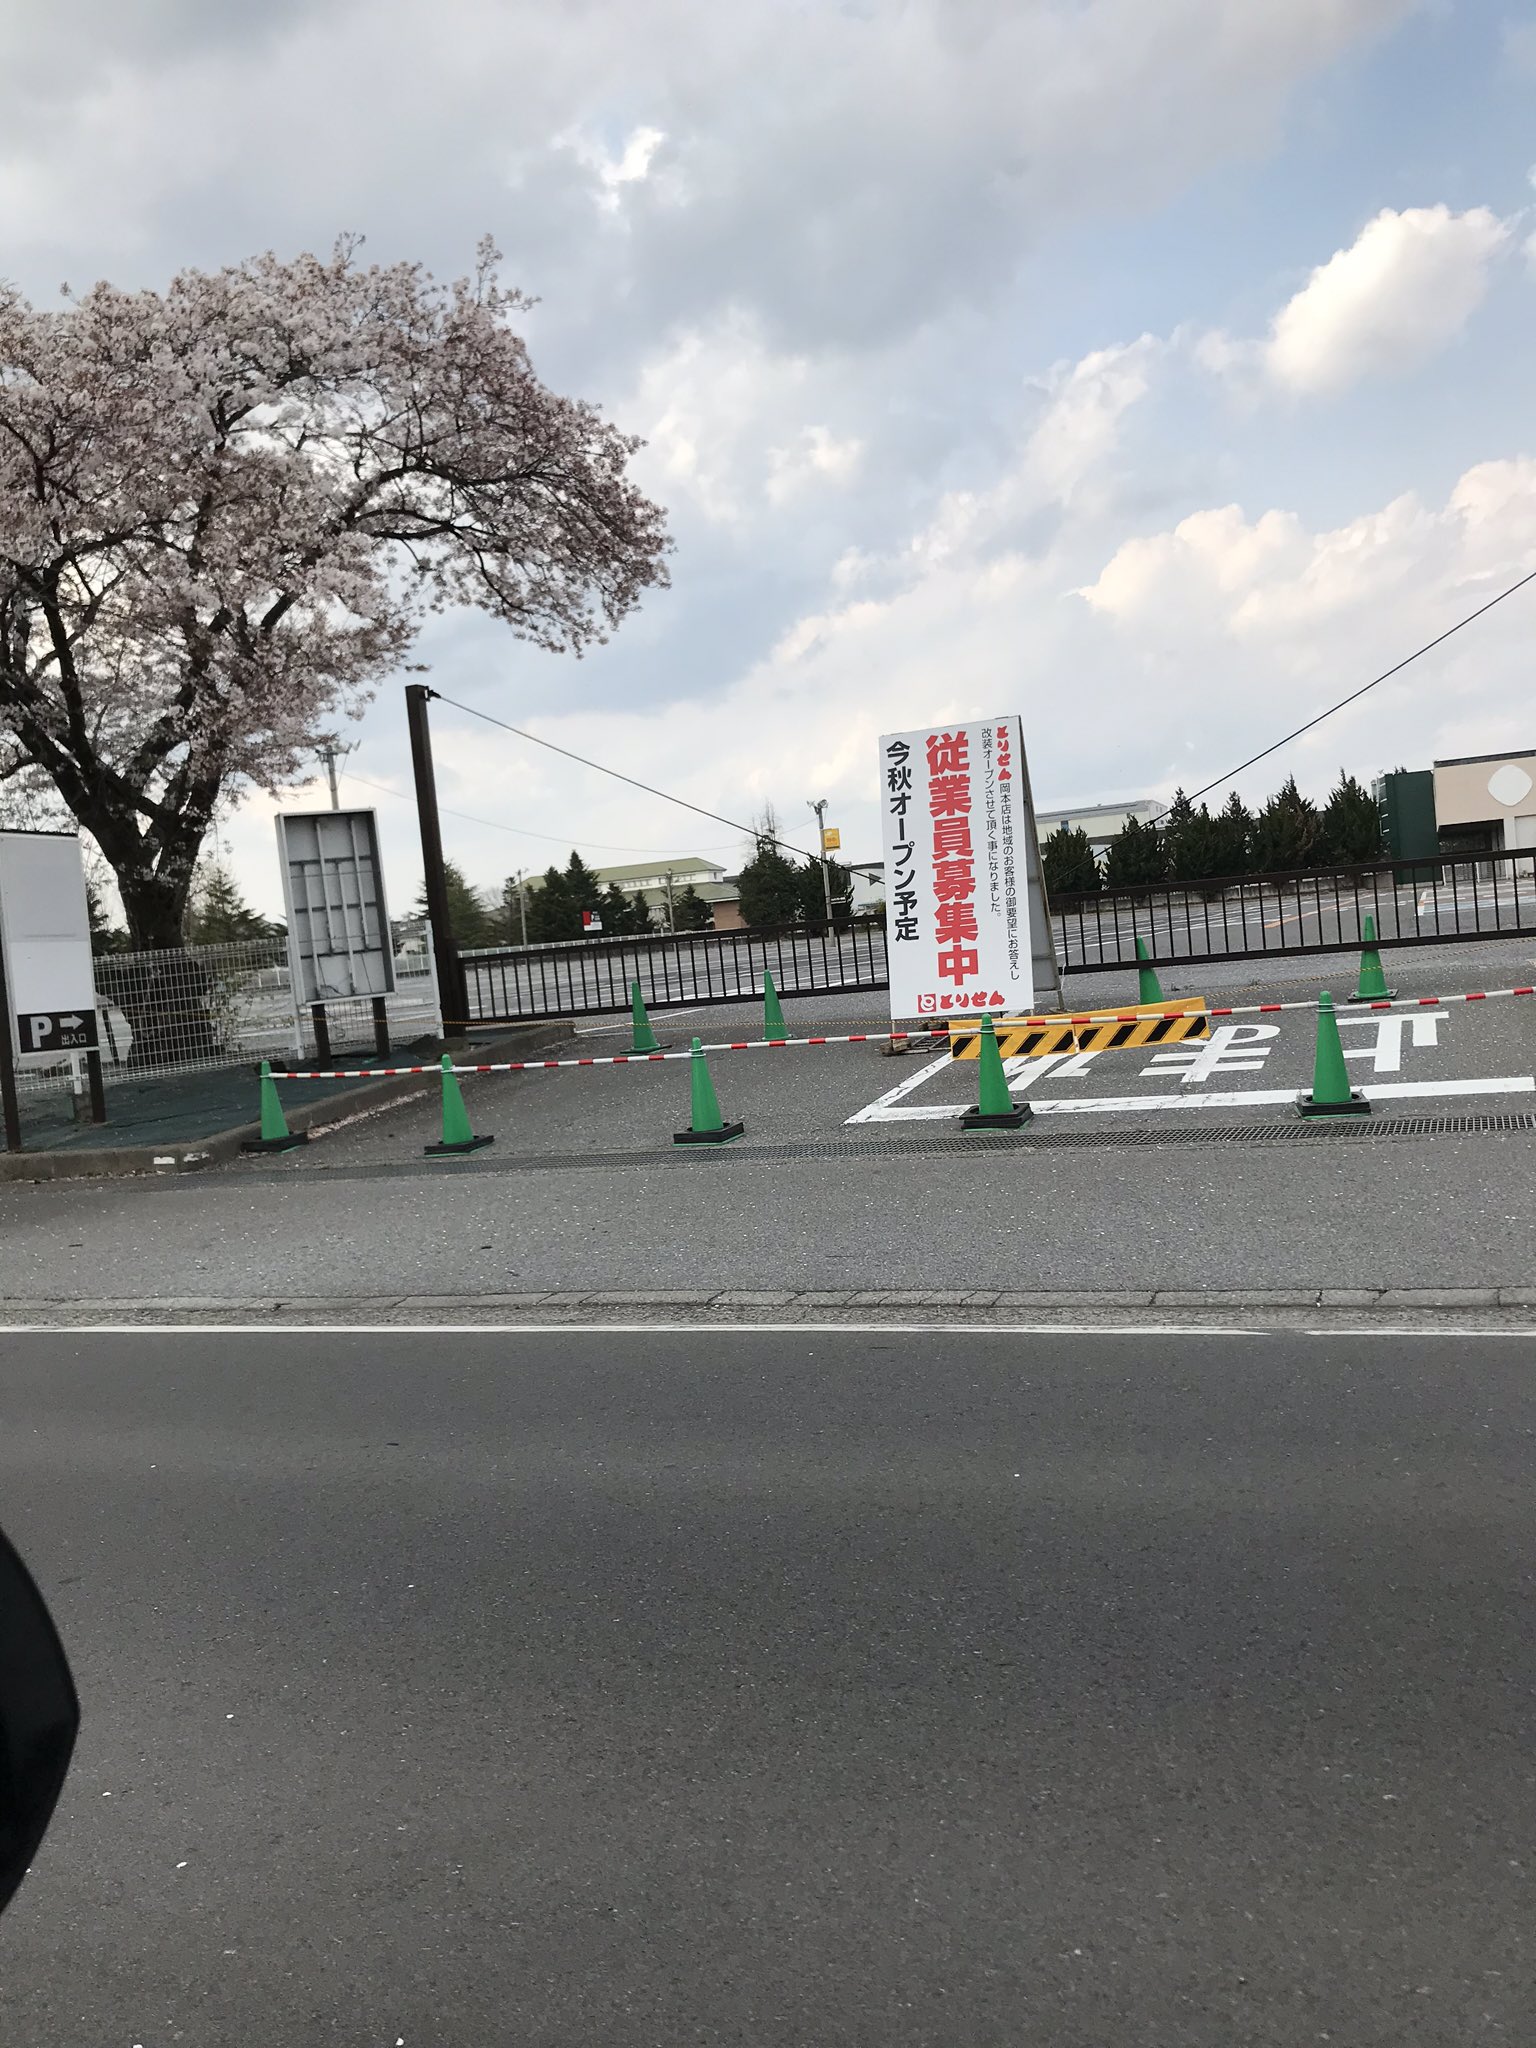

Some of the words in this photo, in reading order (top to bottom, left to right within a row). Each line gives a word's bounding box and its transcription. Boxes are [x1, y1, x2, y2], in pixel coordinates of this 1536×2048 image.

[887, 740, 919, 942] 今秋オープン予定
[926, 731, 979, 986] 従業員募集中
[940, 990, 1005, 1009] とりせん
[30, 1016, 52, 1048] P
[61, 1033, 87, 1045] 出入口
